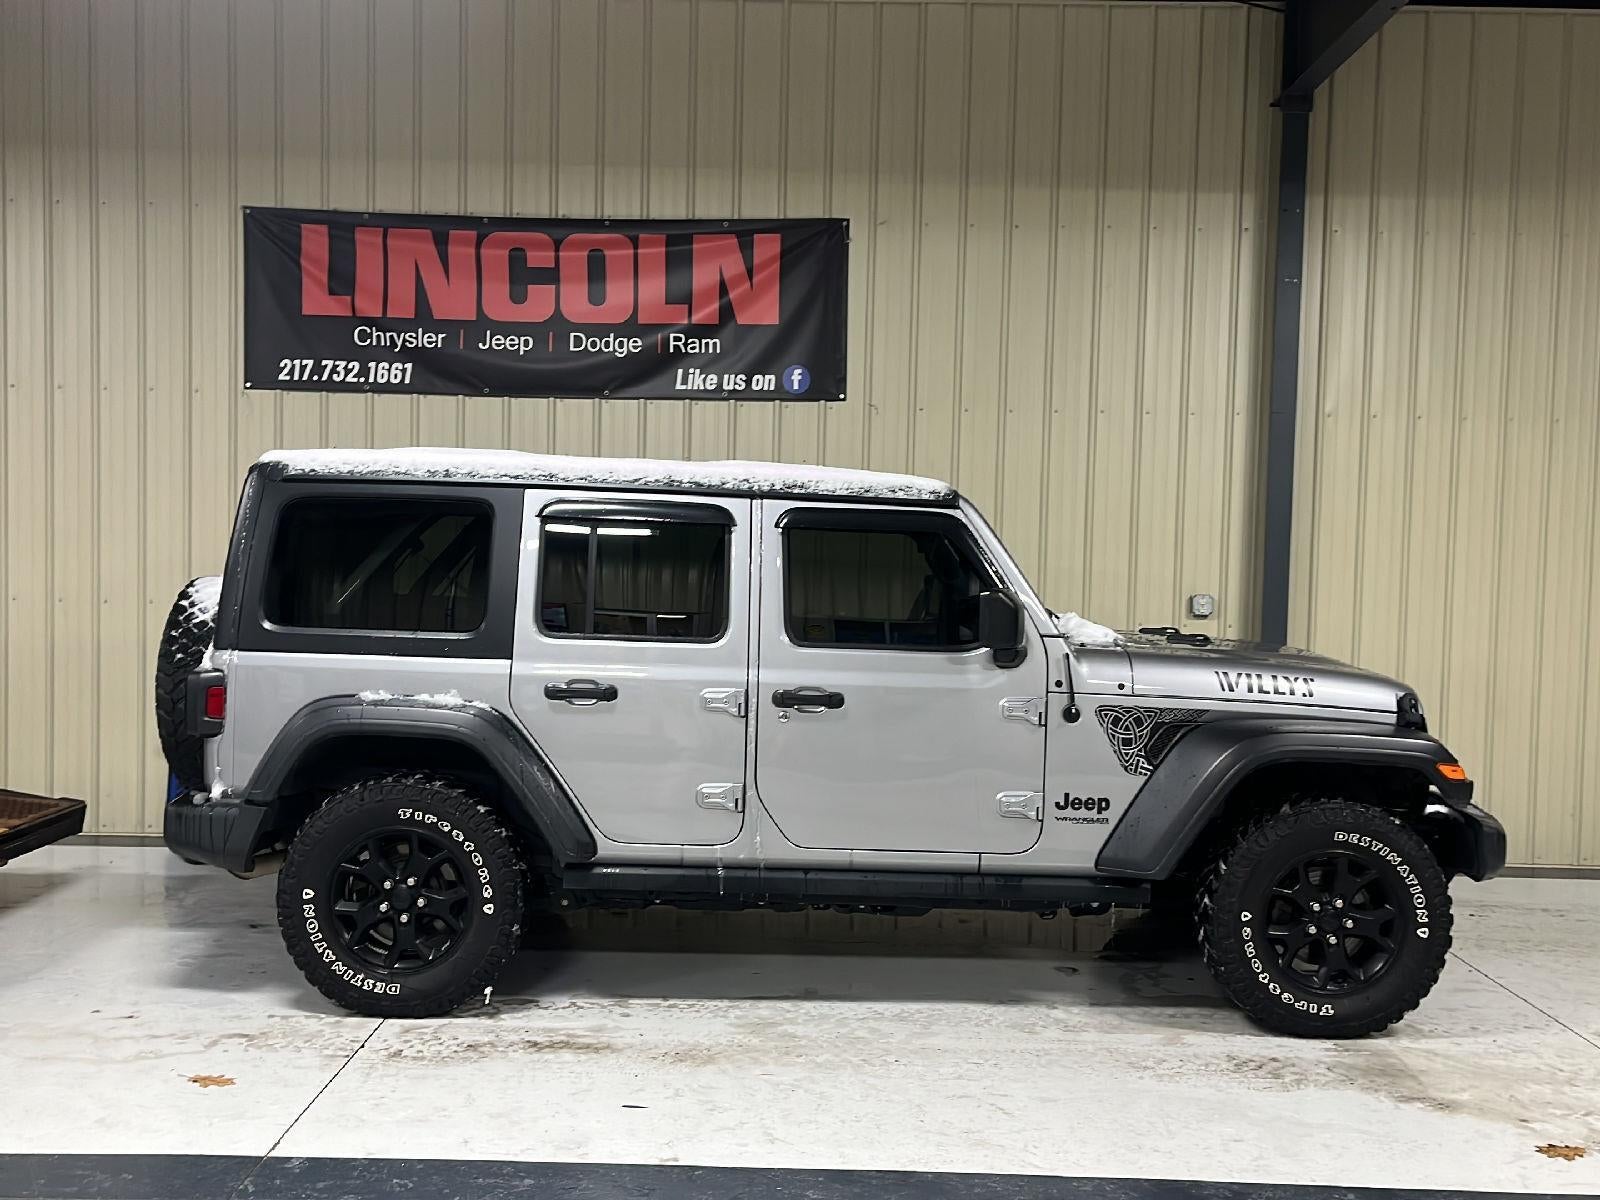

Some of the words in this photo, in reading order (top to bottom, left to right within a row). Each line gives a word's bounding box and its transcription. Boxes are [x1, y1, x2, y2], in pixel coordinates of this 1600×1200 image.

[300, 223, 781, 325] LINCOLN
[353, 325, 446, 352] Chrysler
[478, 331, 534, 356] Jeep
[568, 333, 643, 358] Dodge
[669, 333, 721, 354] Ram
[277, 358, 414, 385] 217.732.1661
[675, 368, 719, 392] Like
[723, 374, 747, 391] us
[751, 374, 776, 391] on
[1214, 670, 1315, 698] WILLYS
[1054, 792, 1111, 815] Jeep
[1333, 831, 1430, 923] DESTINATION
[302, 903, 401, 995] DESTINATION
